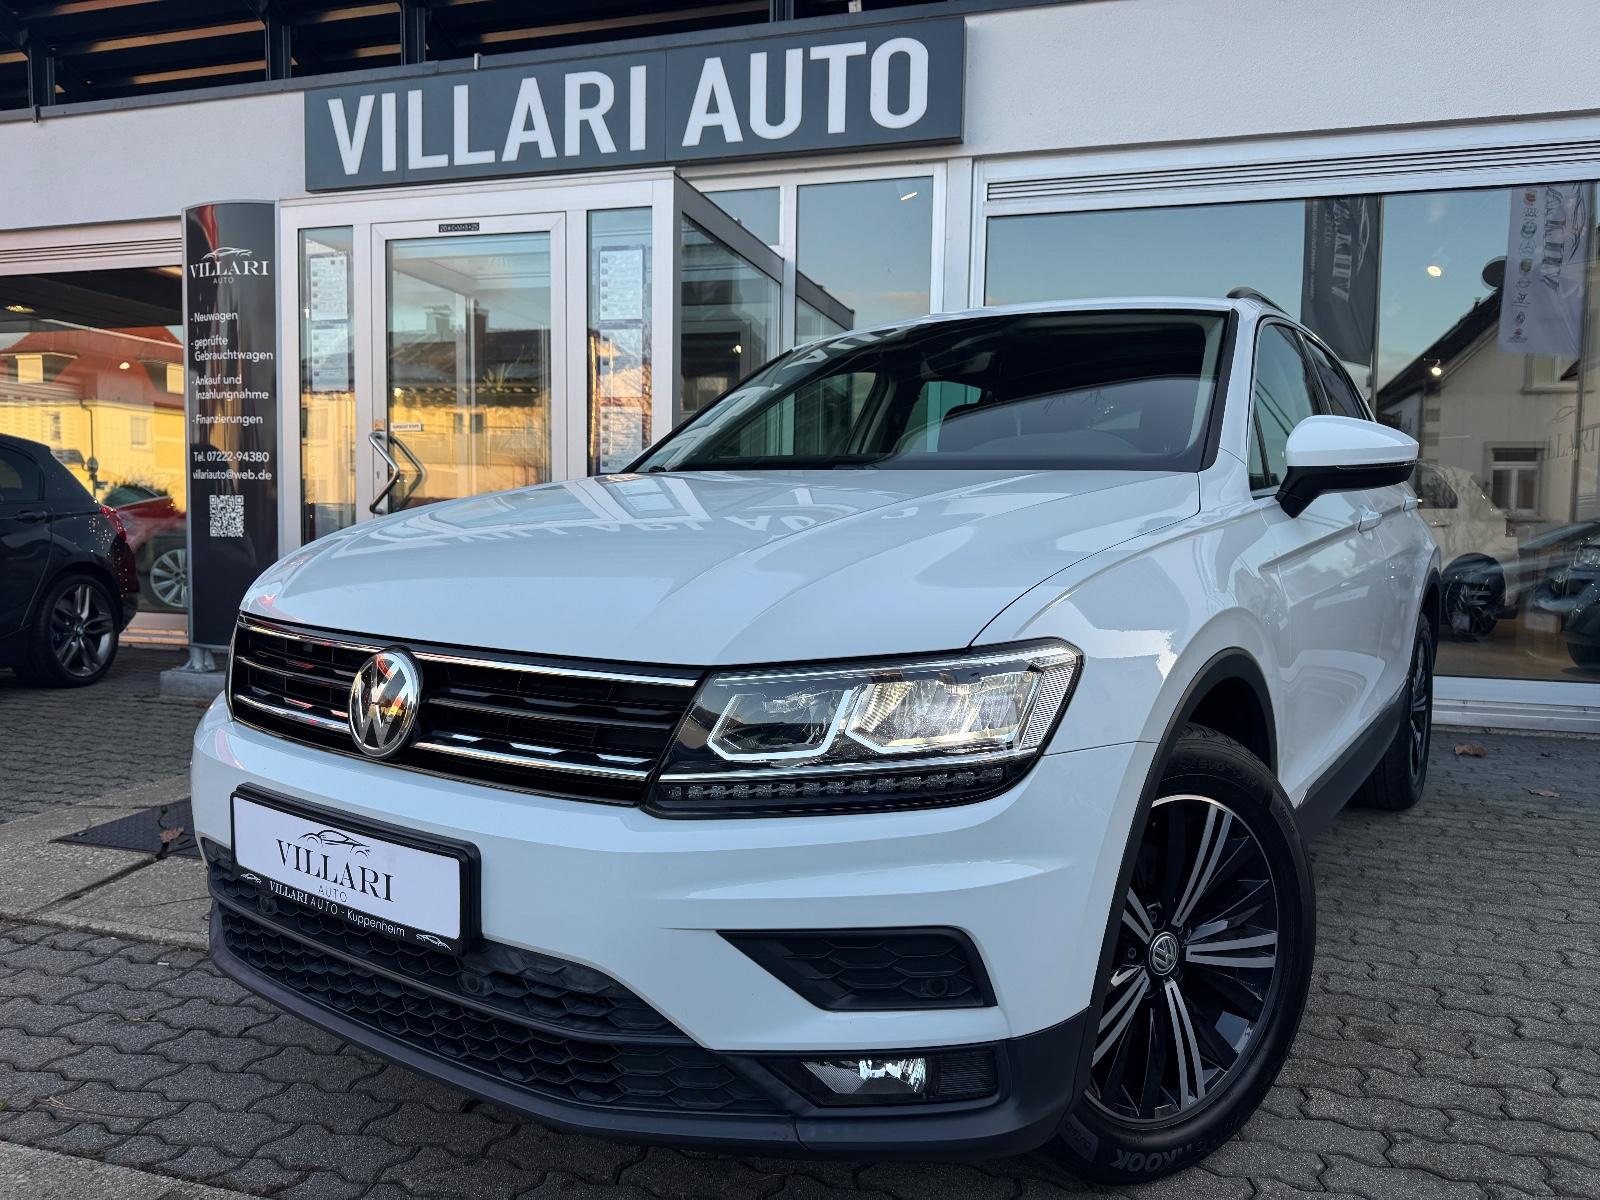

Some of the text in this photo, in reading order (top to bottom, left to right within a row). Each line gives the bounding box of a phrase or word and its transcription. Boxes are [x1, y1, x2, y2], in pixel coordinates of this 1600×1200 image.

[327, 37, 930, 177] VILLARI AUTO
[190, 260, 270, 278] VILLARI
[212, 276, 235, 285] AUTO
[194, 350, 274, 363] Gebrauchtwagen
[223, 374, 243, 385] und
[195, 389, 270, 401] Inzahlungnahme
[193, 451, 270, 463] Tel. 07222-94380
[192, 468, 273, 481] villariauto@web.de
[275, 837, 395, 903] VILLARI
[318, 884, 348, 903] AUTO
[269, 880, 309, 905] VILLARI
[309, 896, 338, 915] AUTO
[347, 907, 405, 937] Kuppenheim
